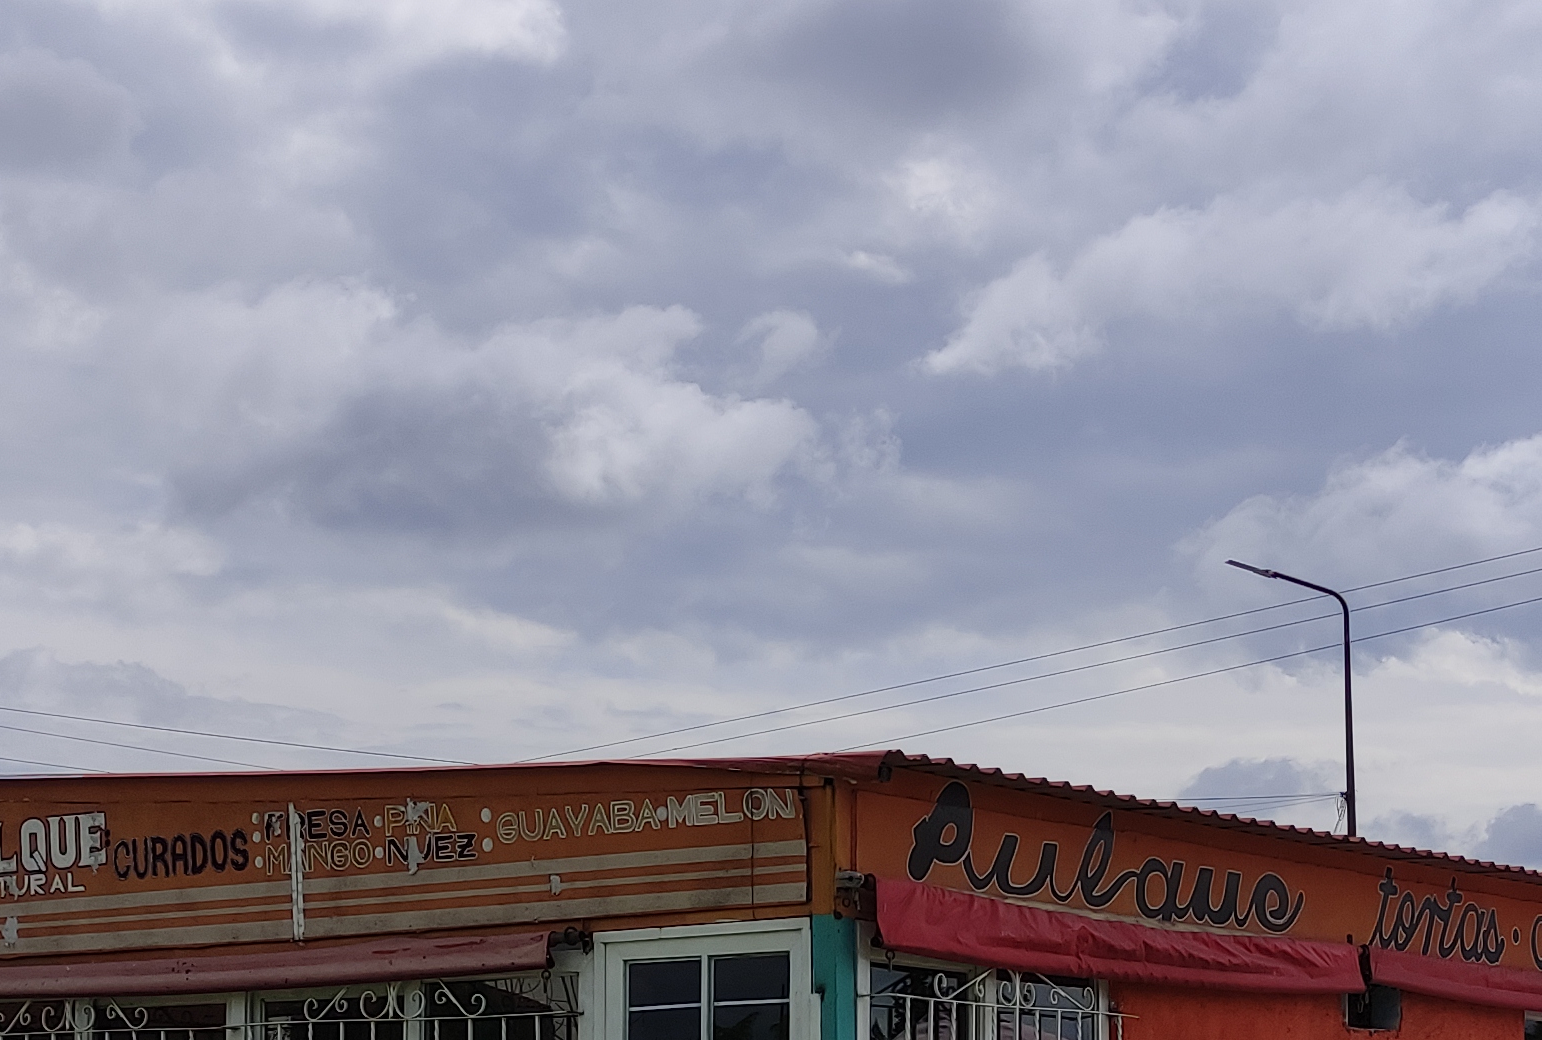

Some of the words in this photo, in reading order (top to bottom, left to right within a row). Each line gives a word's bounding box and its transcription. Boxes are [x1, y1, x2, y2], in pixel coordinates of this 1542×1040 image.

[496, 799, 660, 843] GUAYABA
[667, 788, 796, 828] MELON
[112, 828, 250, 880] CURADOS
[1368, 866, 1505, 965] tortas
